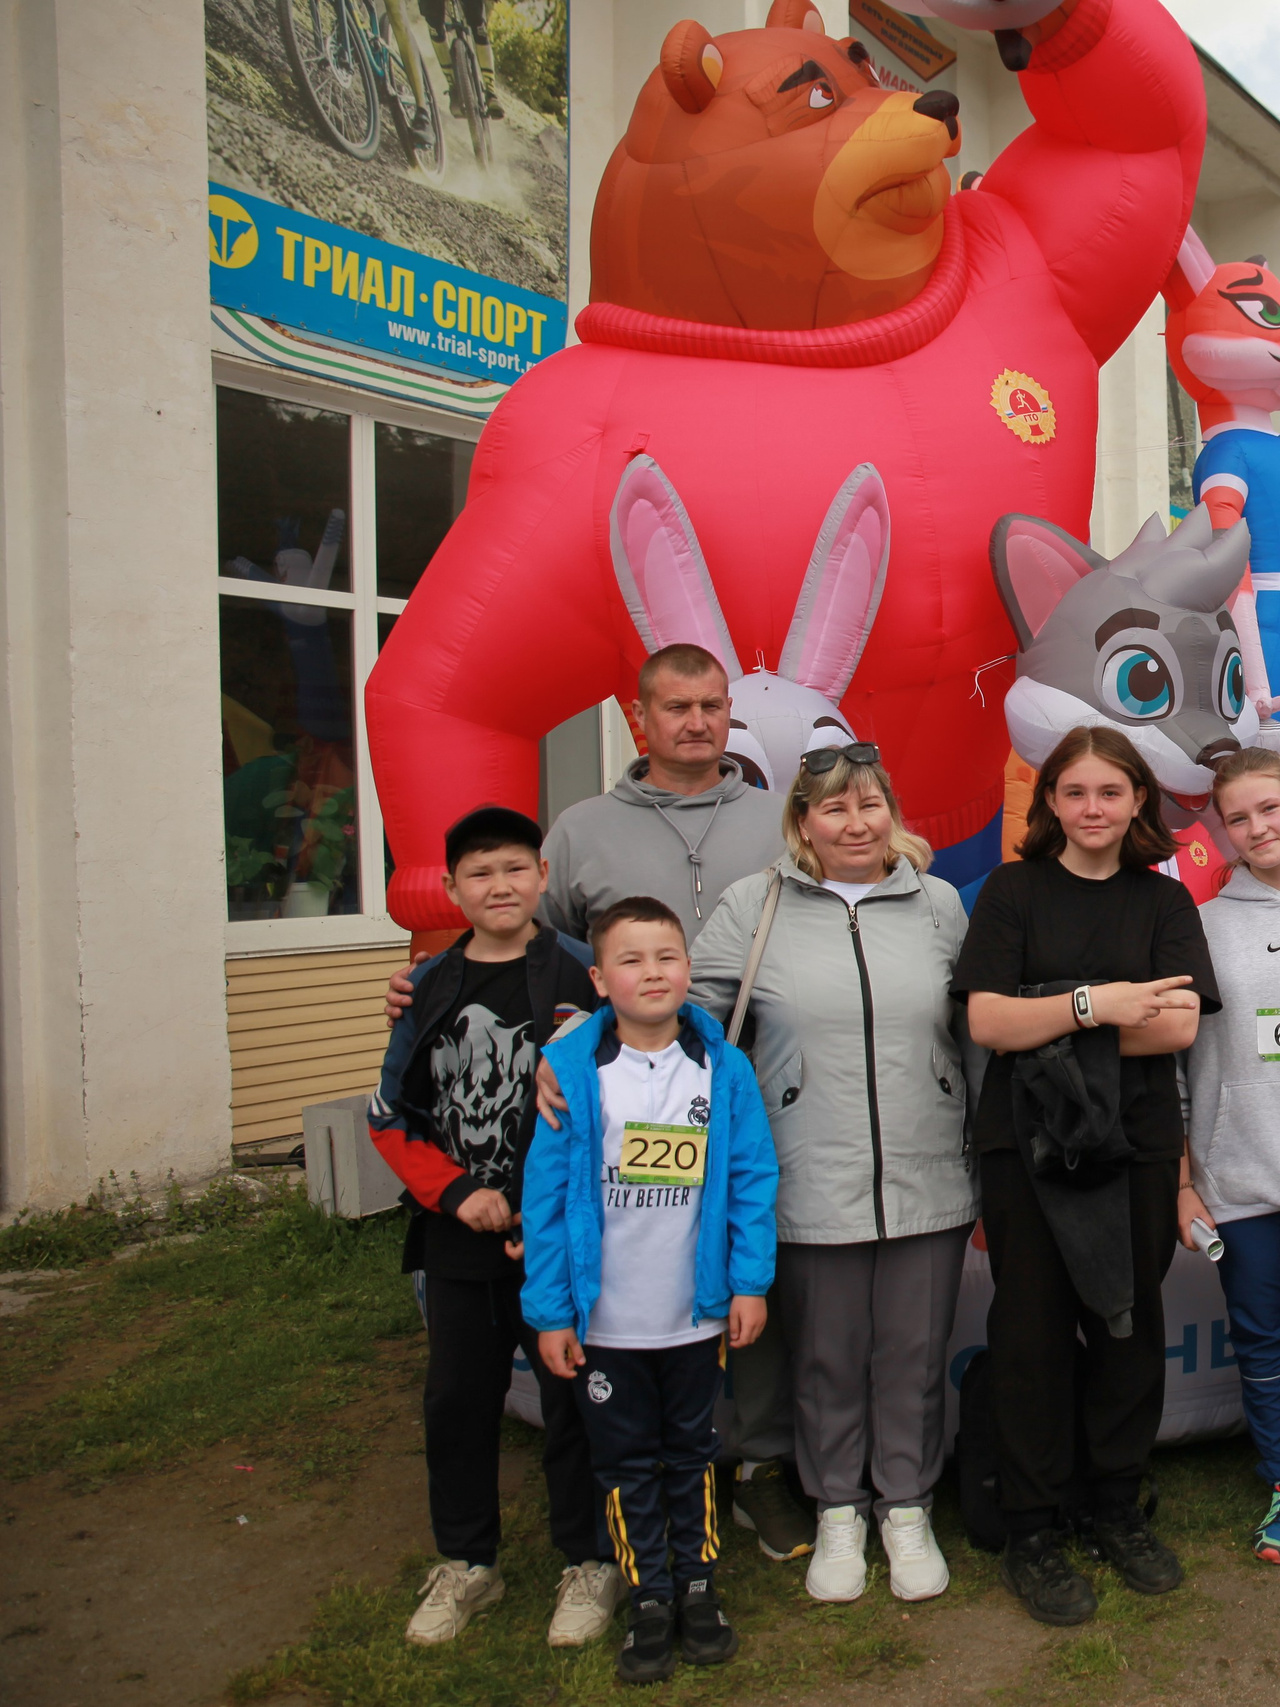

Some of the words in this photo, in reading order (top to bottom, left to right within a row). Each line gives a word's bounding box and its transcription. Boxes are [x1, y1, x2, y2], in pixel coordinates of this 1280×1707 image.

[388, 320, 537, 374] www.trial-sport.r
[1024, 413, 1039, 422] ГТО
[627, 1137, 698, 1170] 220
[607, 1188, 631, 1207] FLY
[636, 1186, 690, 1207] BETTER
